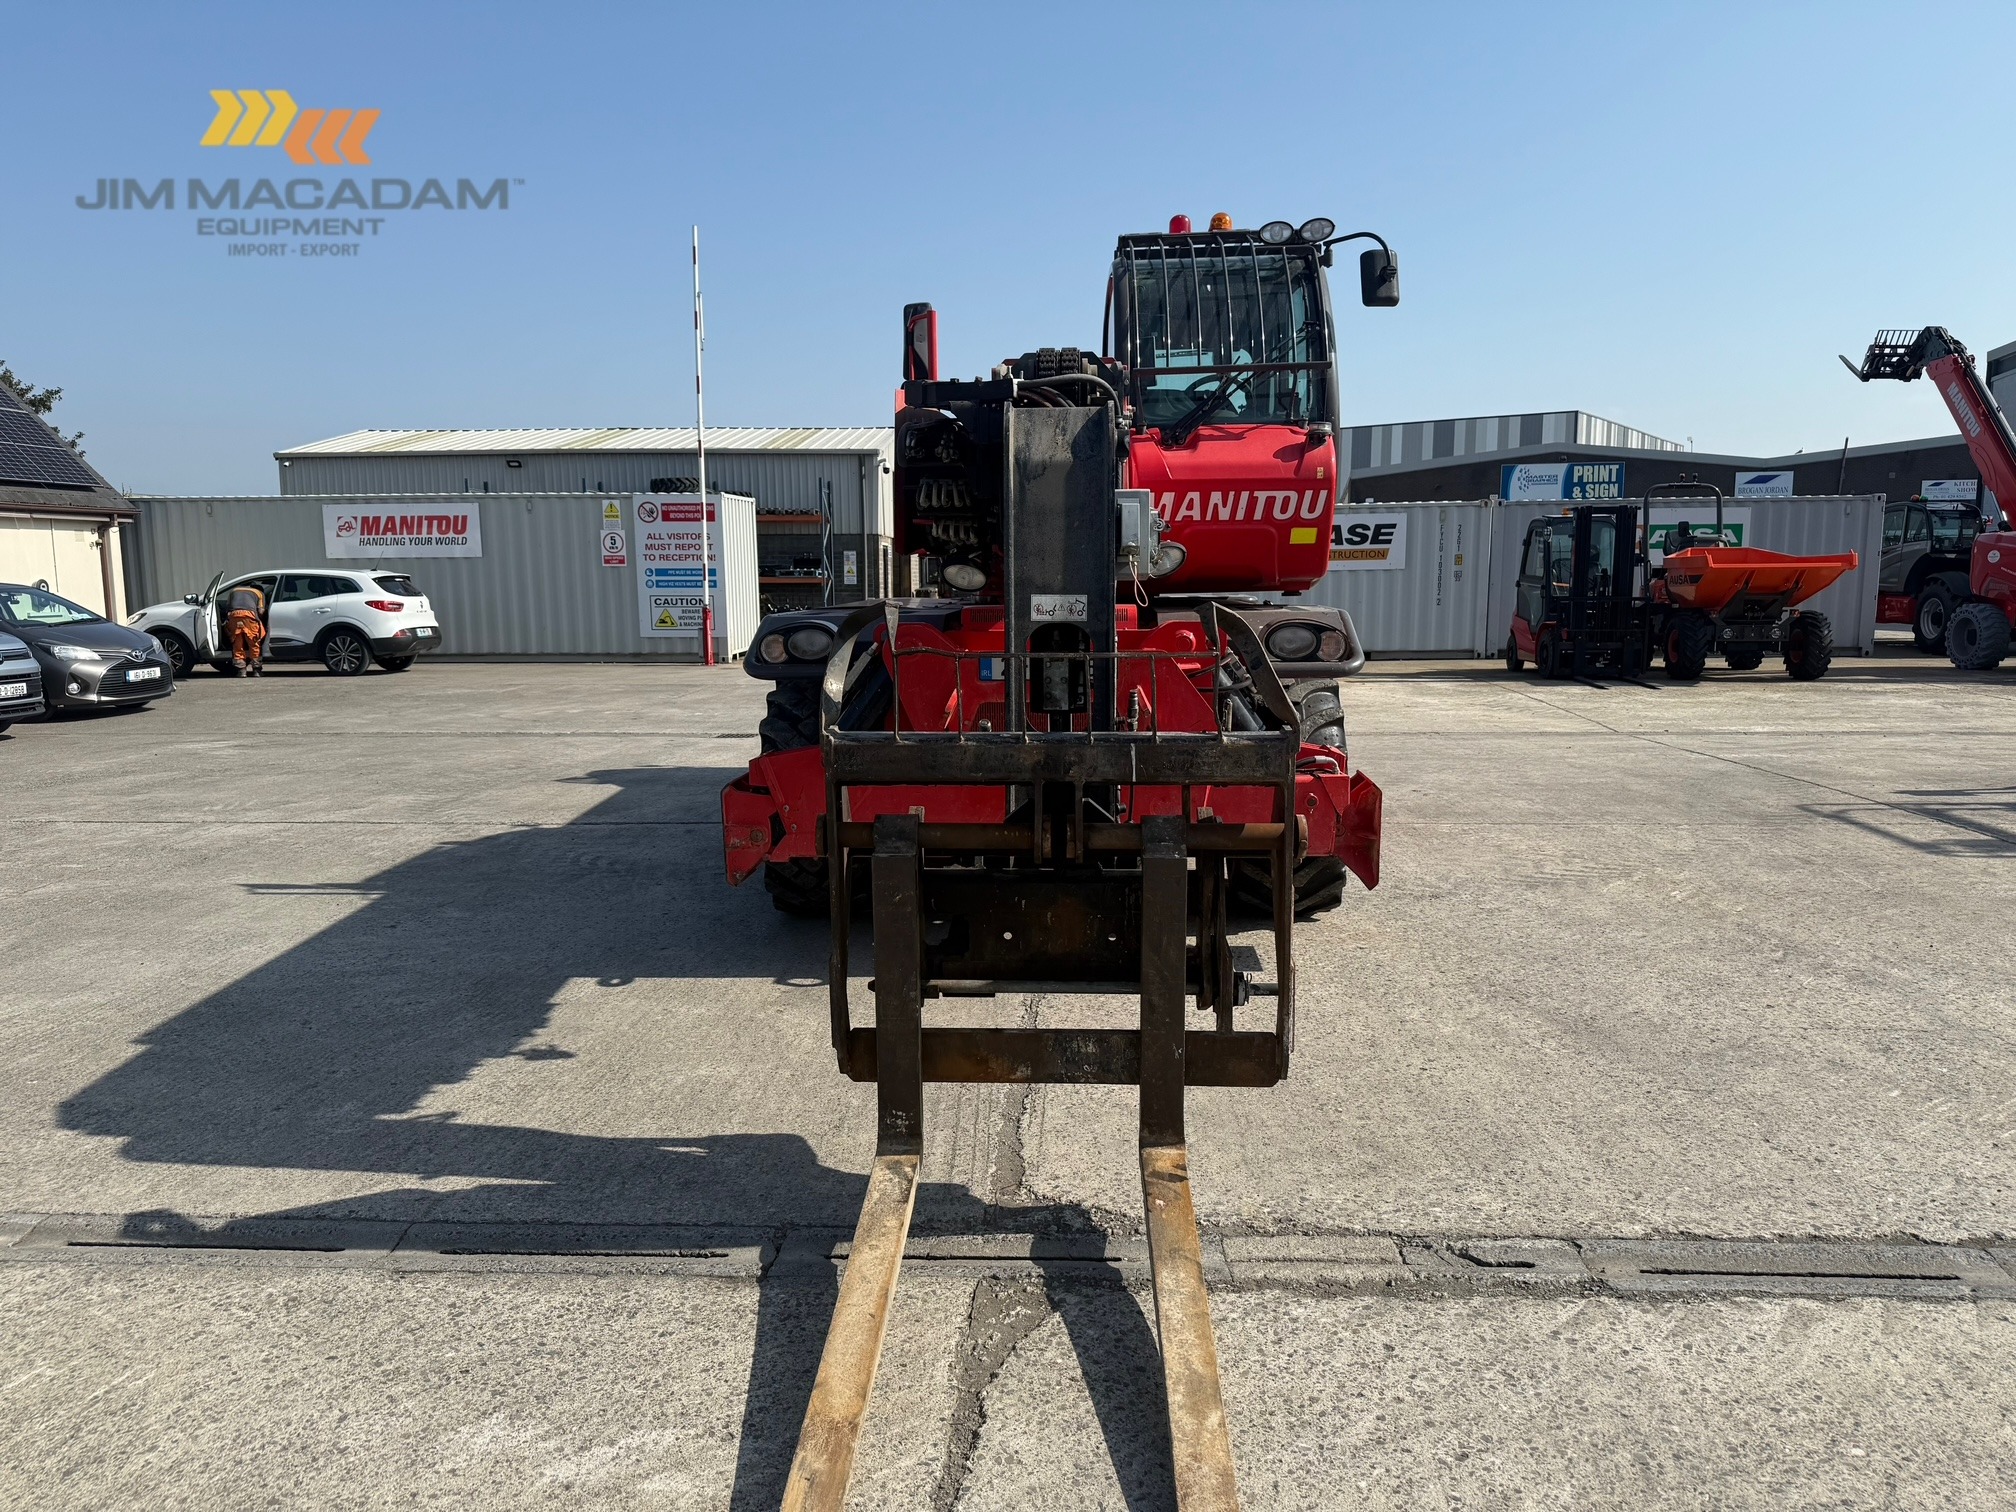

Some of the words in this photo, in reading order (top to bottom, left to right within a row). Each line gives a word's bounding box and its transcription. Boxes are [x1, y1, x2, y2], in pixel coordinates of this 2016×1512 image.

[1946, 381, 1981, 438] MANITOU
[1573, 464, 1619, 483] PRINT
[1572, 486, 1583, 498] &
[1585, 483, 1619, 498] SIGN
[1737, 486, 1763, 495] BROGAN
[1764, 486, 1789, 494] JORDAN
[1149, 489, 1329, 522] MANITOU
[359, 515, 468, 536] MANITOU
[646, 532, 665, 541] ALL
[1330, 523, 1397, 546] ASE
[1648, 528, 1739, 544] ASA
[359, 537, 406, 547] HANDLING
[409, 537, 433, 546] YOUR
[435, 536, 468, 546] WORLD
[610, 535, 617, 546] 5
[644, 543, 672, 551] MUST
[674, 543, 714, 551] REPOT
[642, 553, 656, 562] TO
[1329, 550, 1385, 559] TRUCTION
[1669, 575, 1690, 585] AUSA
[654, 597, 709, 606] CAUTION
